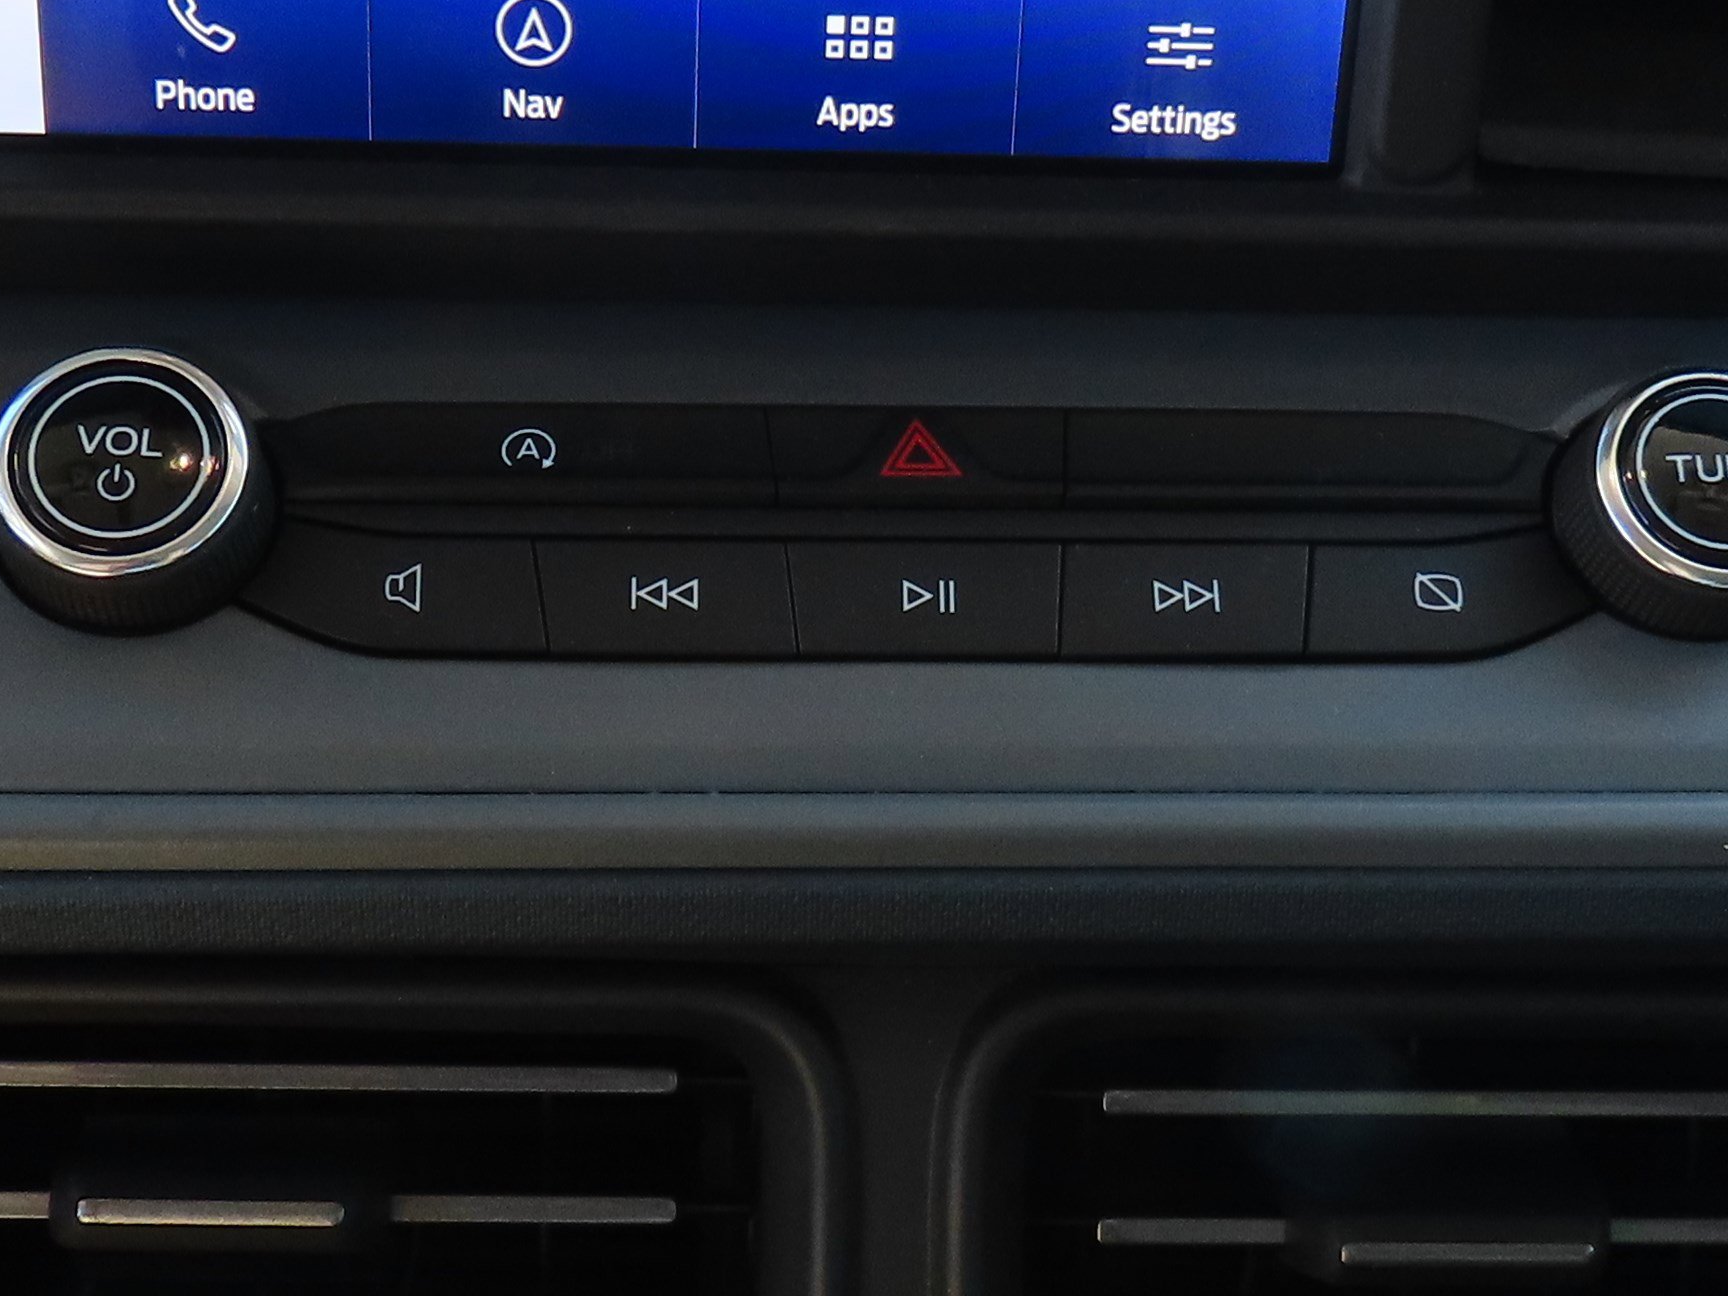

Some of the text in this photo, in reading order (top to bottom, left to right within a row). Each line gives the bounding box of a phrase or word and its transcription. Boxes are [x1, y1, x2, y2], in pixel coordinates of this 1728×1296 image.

[155, 79, 255, 112] Phone
[503, 88, 563, 119] Nav
[817, 96, 894, 132] Apps
[1111, 103, 1236, 141] Settings
[77, 425, 163, 460] VOL
